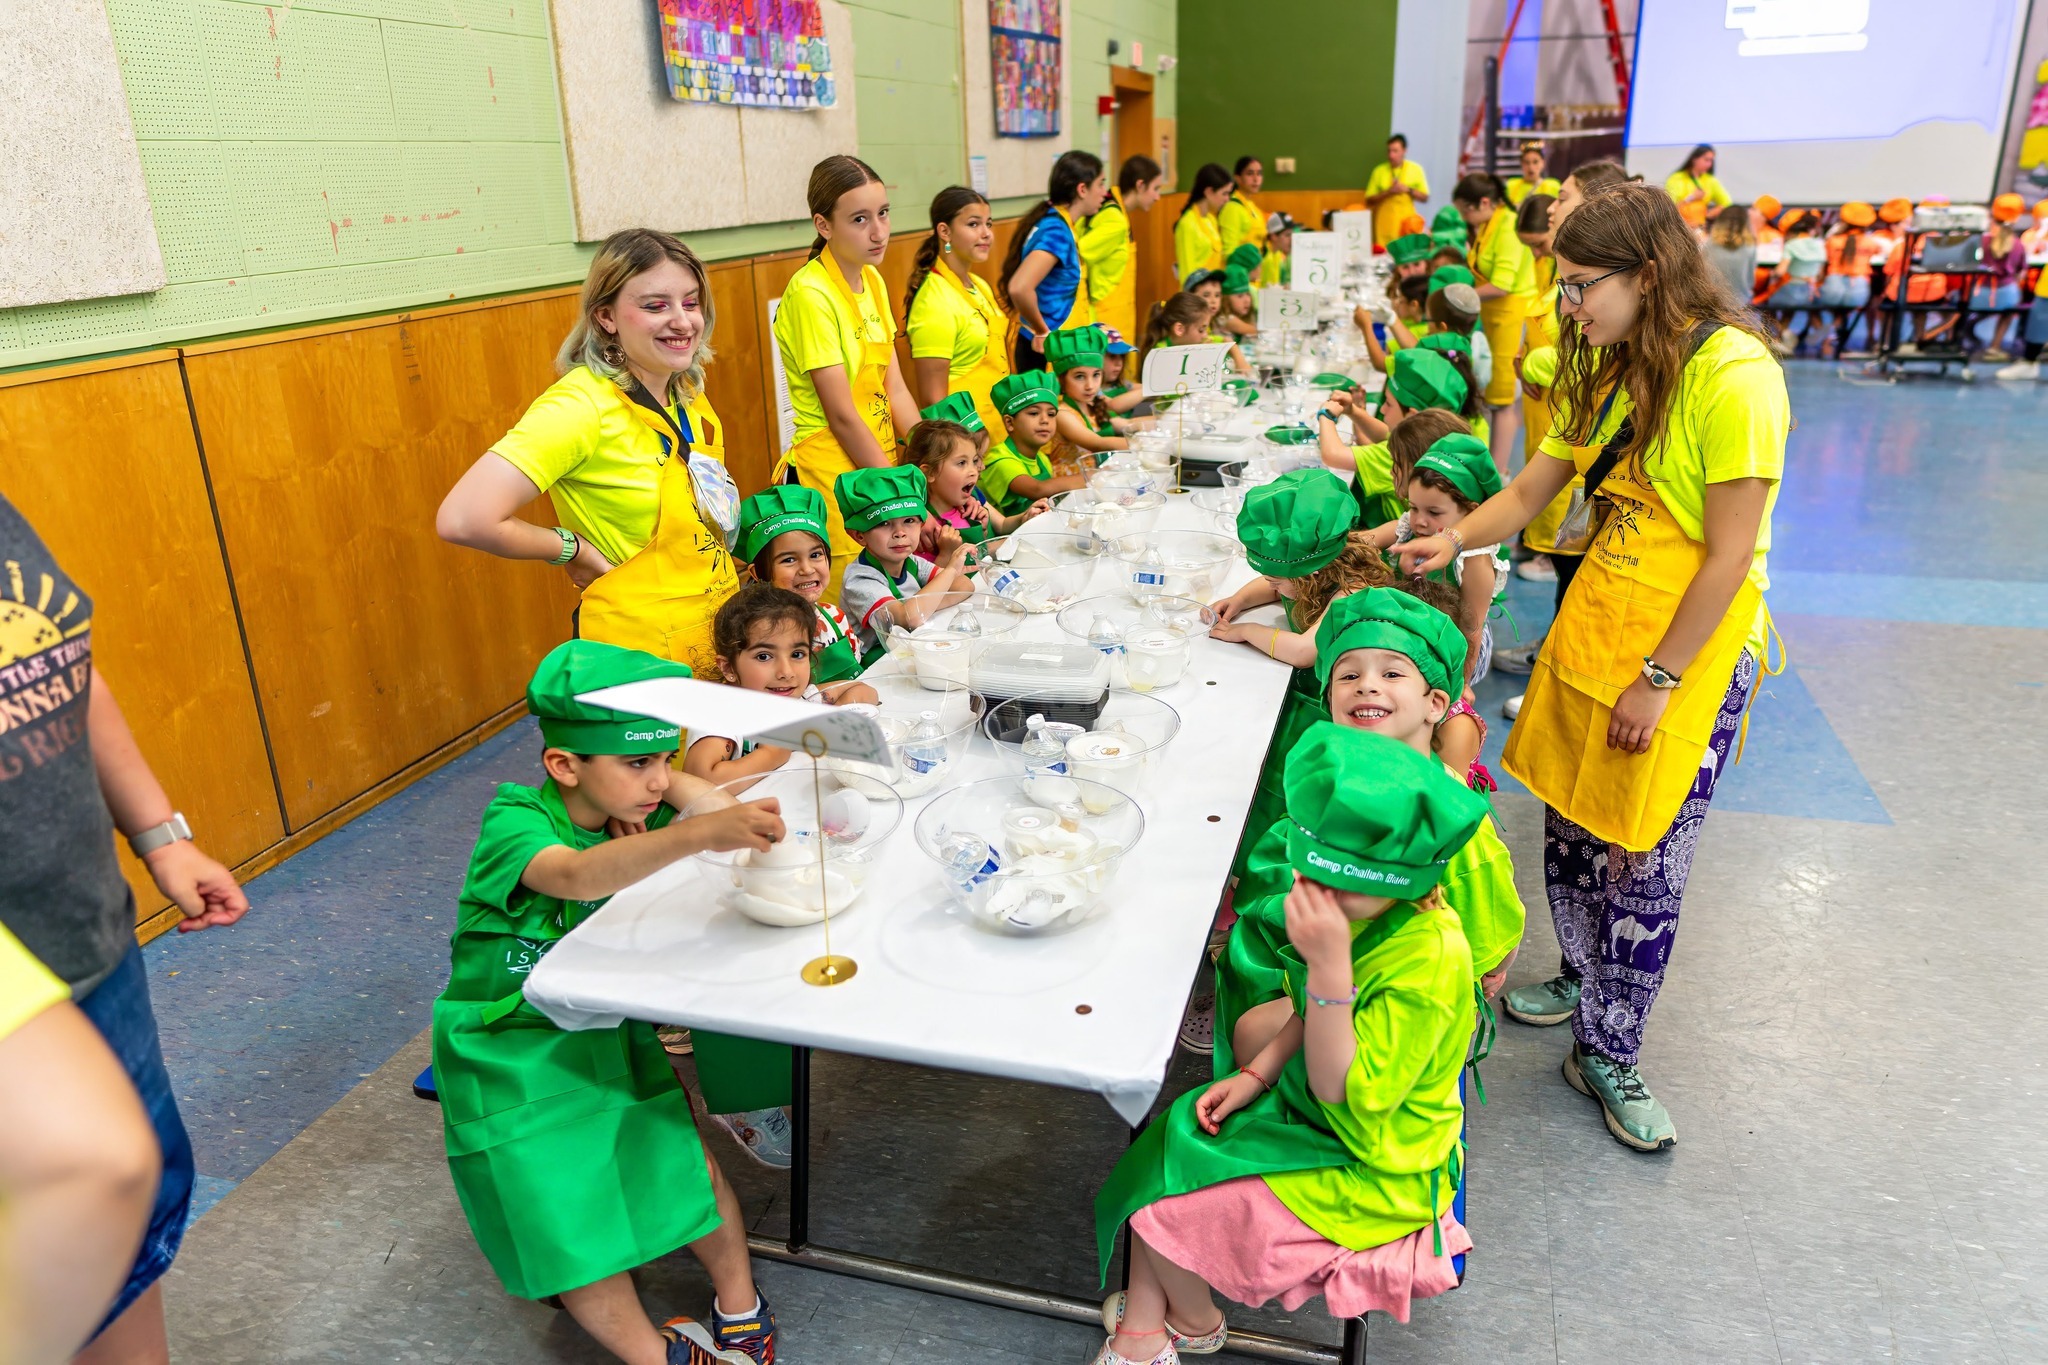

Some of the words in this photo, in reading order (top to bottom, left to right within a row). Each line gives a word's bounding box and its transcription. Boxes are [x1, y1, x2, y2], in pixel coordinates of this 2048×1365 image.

[764, 522, 782, 535] Camp
[624, 730, 655, 741] Camp
[1306, 851, 1342, 874] Camp
[1343, 863, 1384, 882] Challah
